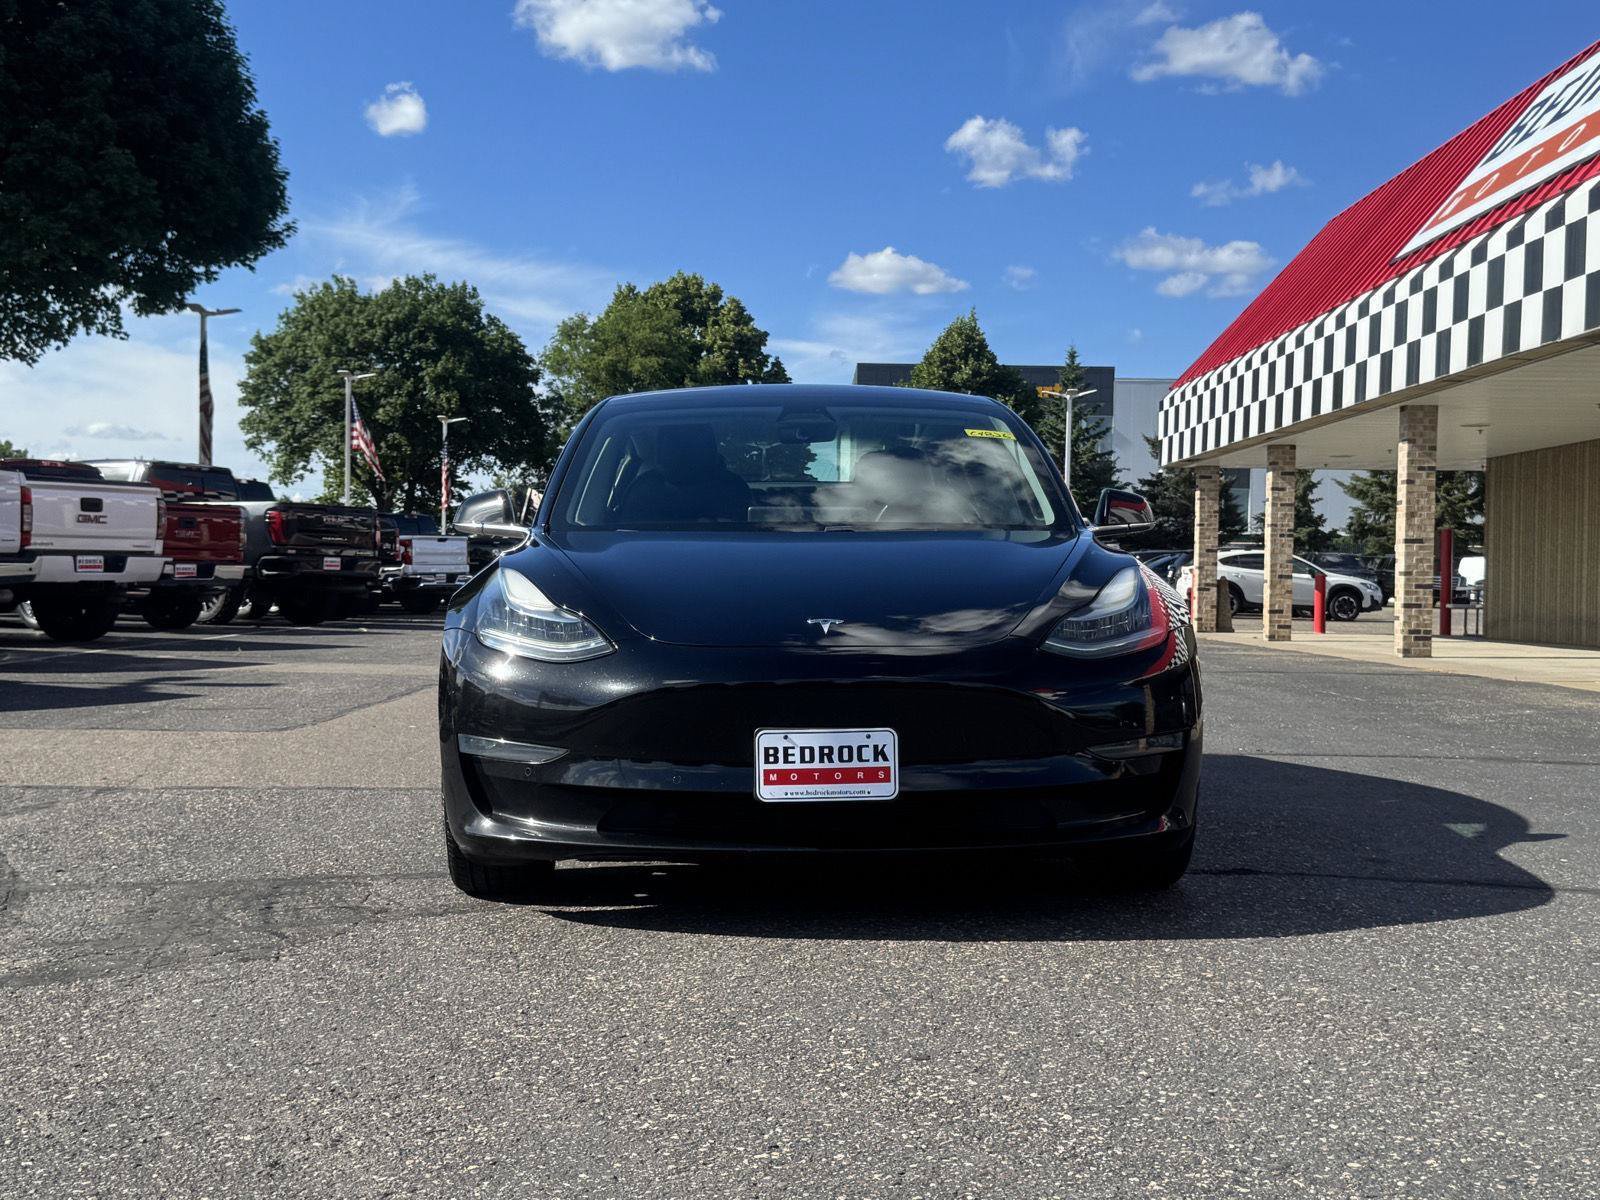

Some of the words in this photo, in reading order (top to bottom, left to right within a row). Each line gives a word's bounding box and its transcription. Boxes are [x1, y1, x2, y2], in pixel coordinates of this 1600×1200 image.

[76, 514, 108, 524] GMC
[763, 743, 890, 765] BEDROCK
[769, 771, 885, 781] MOTORS
[789, 789, 866, 797] www.bedrockmotors.com
